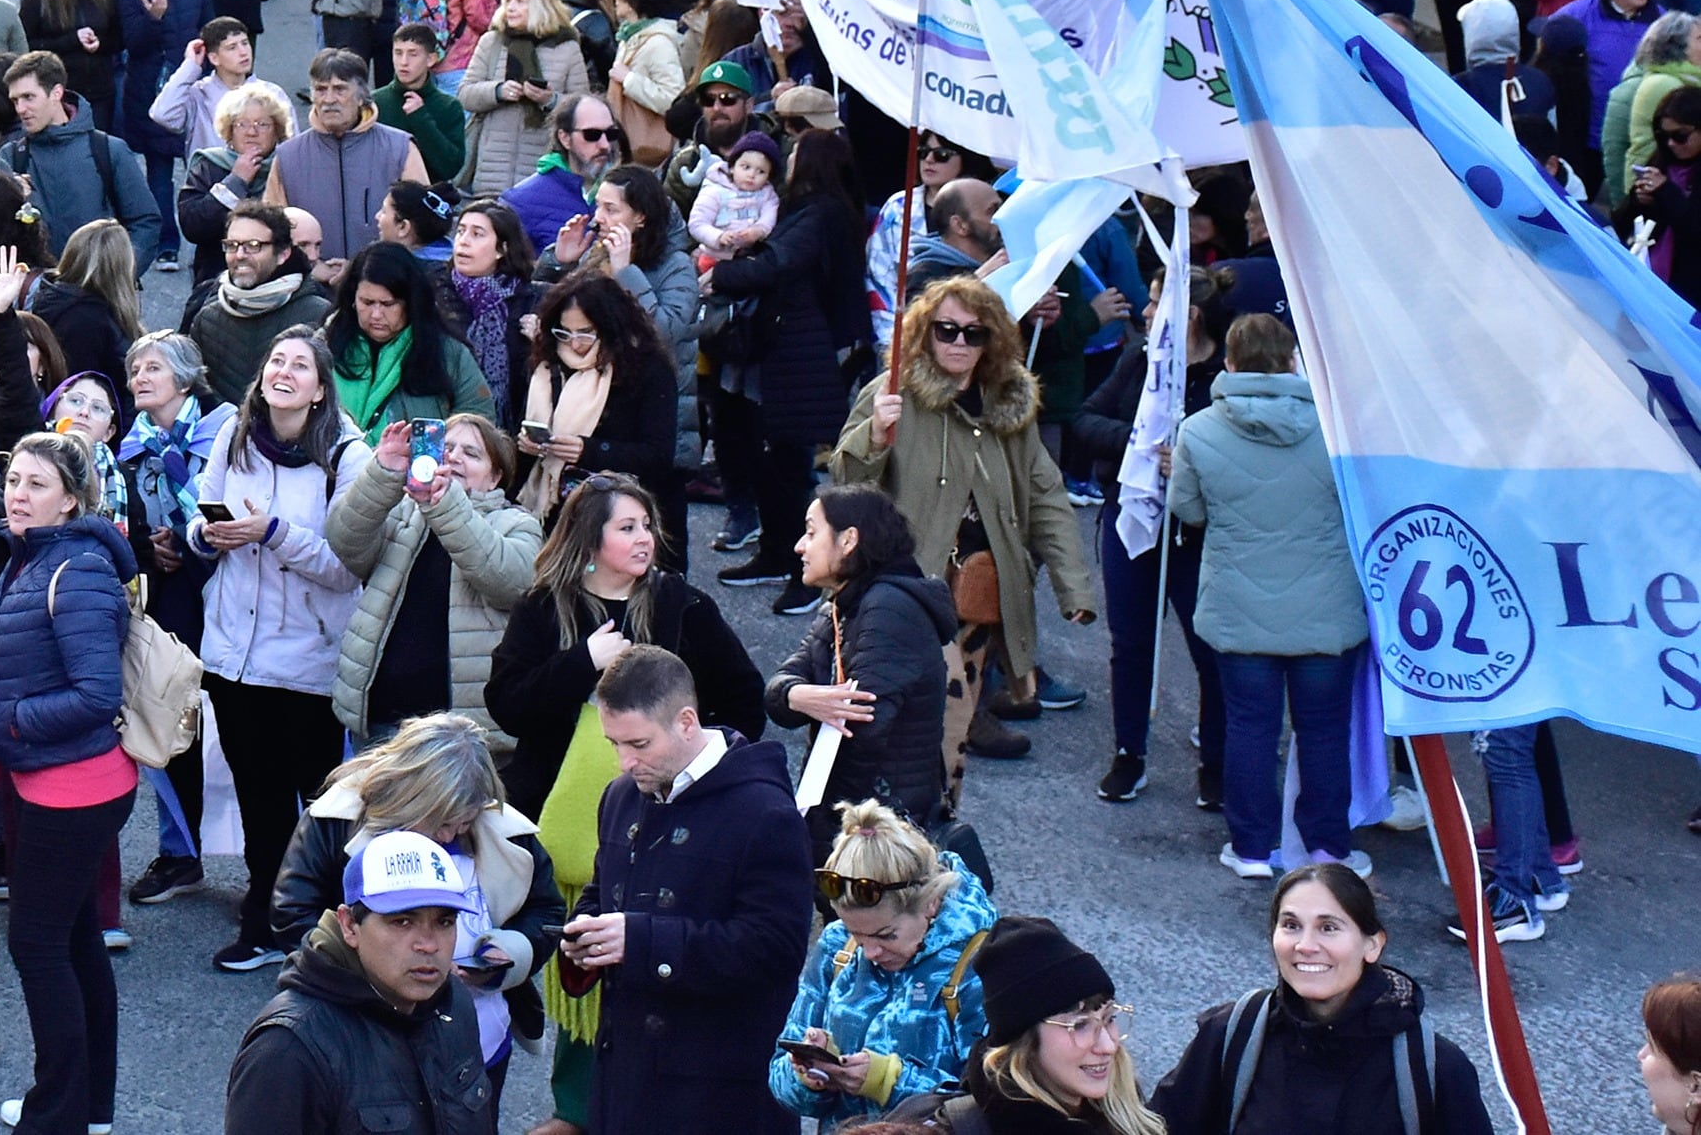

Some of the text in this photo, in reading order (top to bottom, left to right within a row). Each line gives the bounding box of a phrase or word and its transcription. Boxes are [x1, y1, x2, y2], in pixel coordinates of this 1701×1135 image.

[1368, 515, 1520, 621] ORGANIZACIONES
[1397, 559, 1490, 656] 62
[1384, 641, 1516, 692] PERONISTAS
